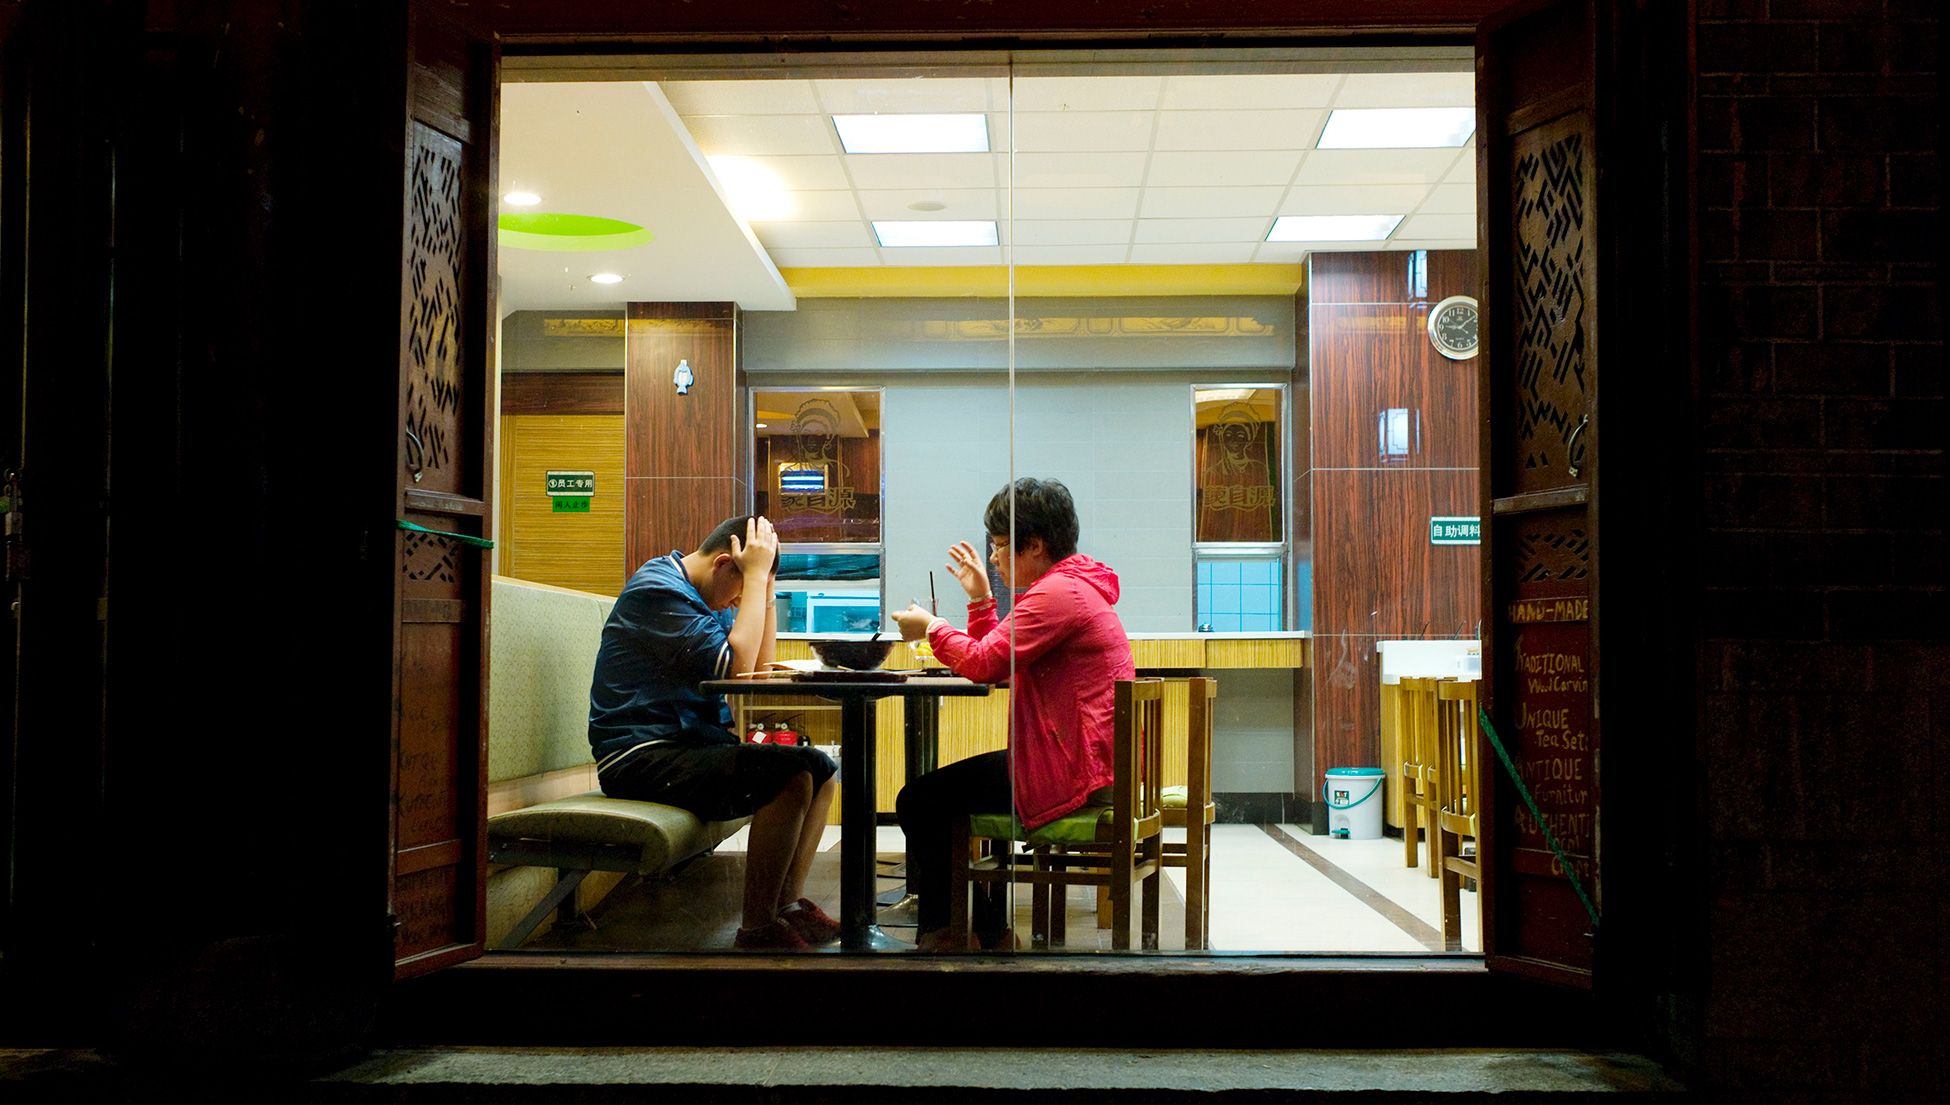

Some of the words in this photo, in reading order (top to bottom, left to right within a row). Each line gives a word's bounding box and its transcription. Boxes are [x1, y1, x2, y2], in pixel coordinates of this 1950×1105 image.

[557, 478, 593, 488] 员工专用
[1507, 599, 1589, 623] HAND-MADE
[1513, 702, 1569, 730] UNIQUE
[1535, 729, 1560, 748] Tea
